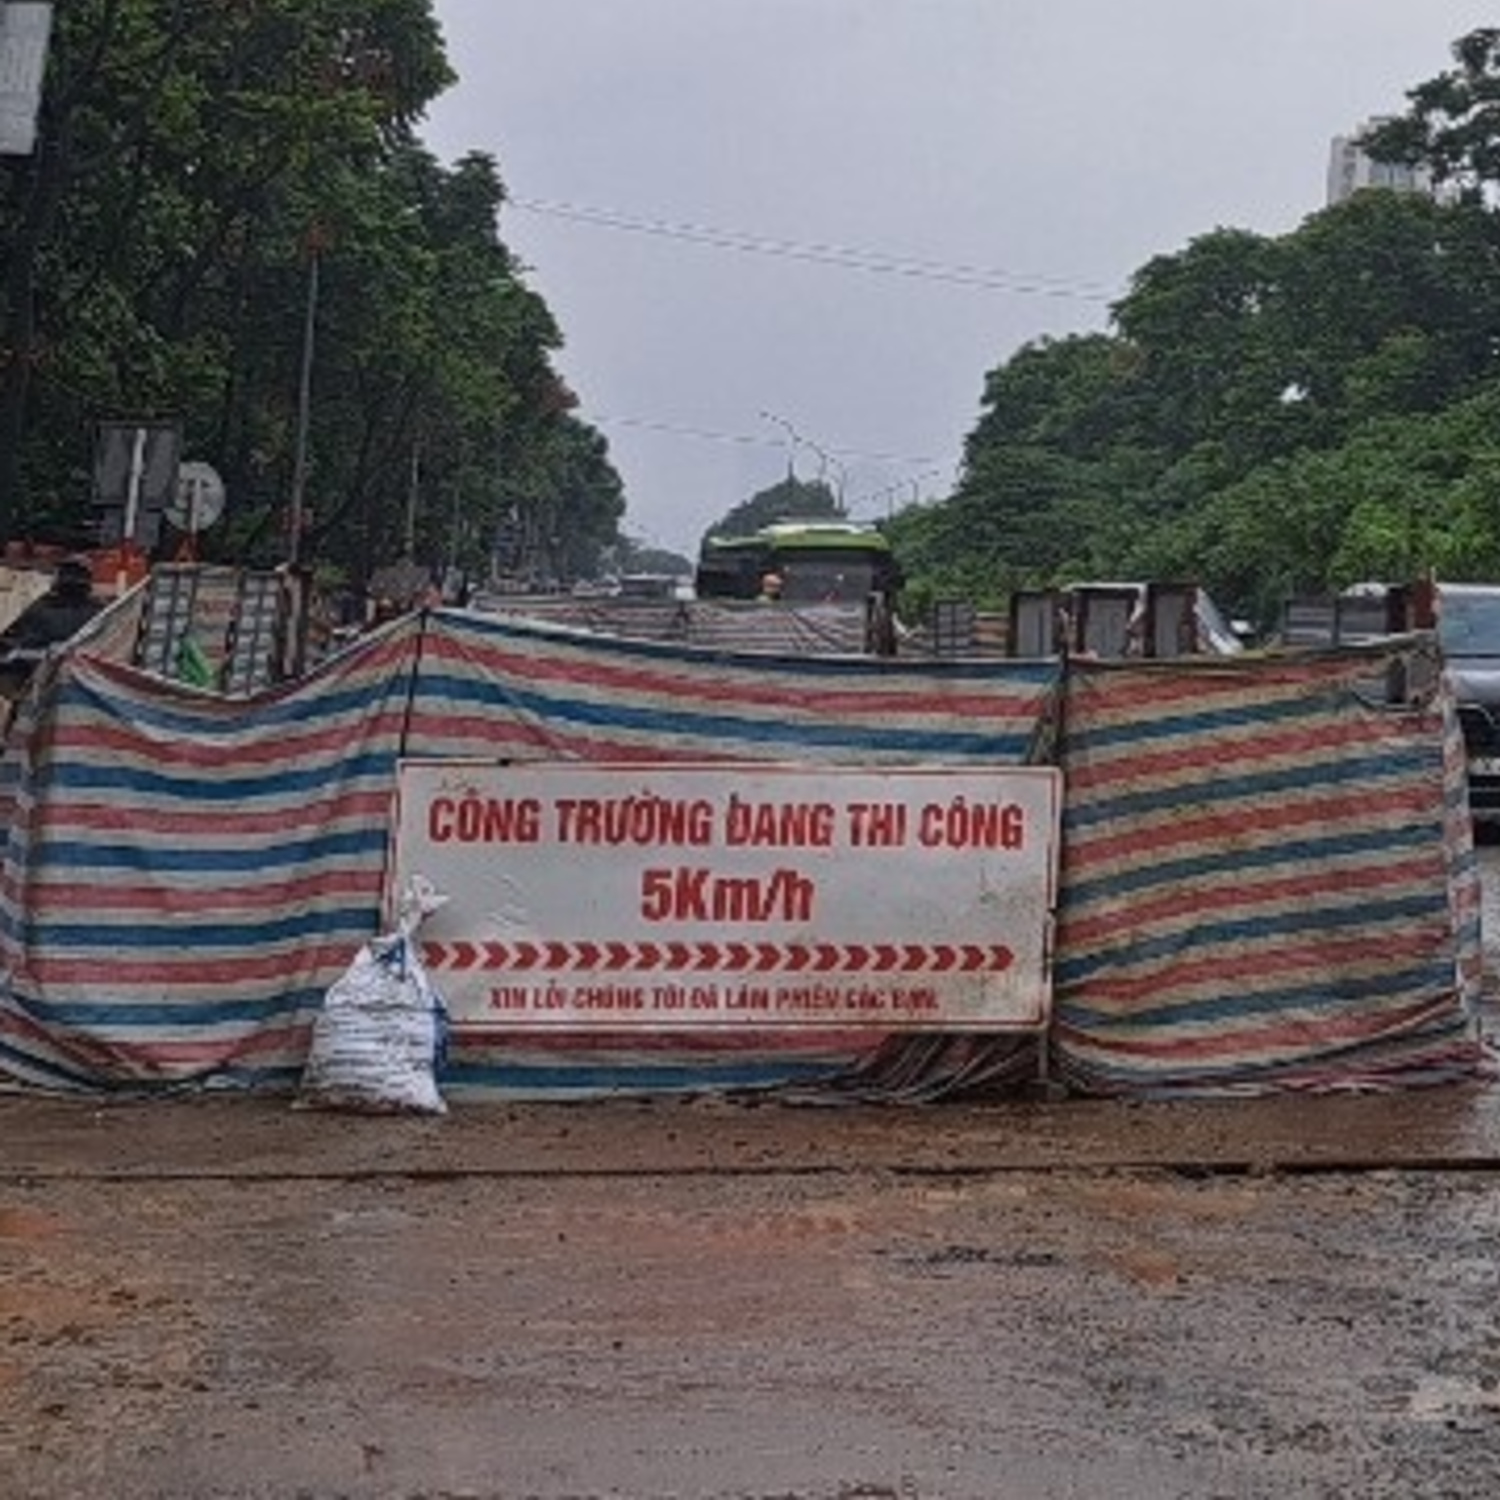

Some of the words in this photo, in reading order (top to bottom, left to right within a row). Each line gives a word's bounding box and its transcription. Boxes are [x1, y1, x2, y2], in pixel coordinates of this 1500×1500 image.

[429, 787, 541, 844] CÔNG
[554, 788, 714, 846] TRƯỜNG
[846, 802, 907, 847] THI
[918, 794, 1024, 850] CÔNG
[641, 867, 815, 921] 5Km/h
